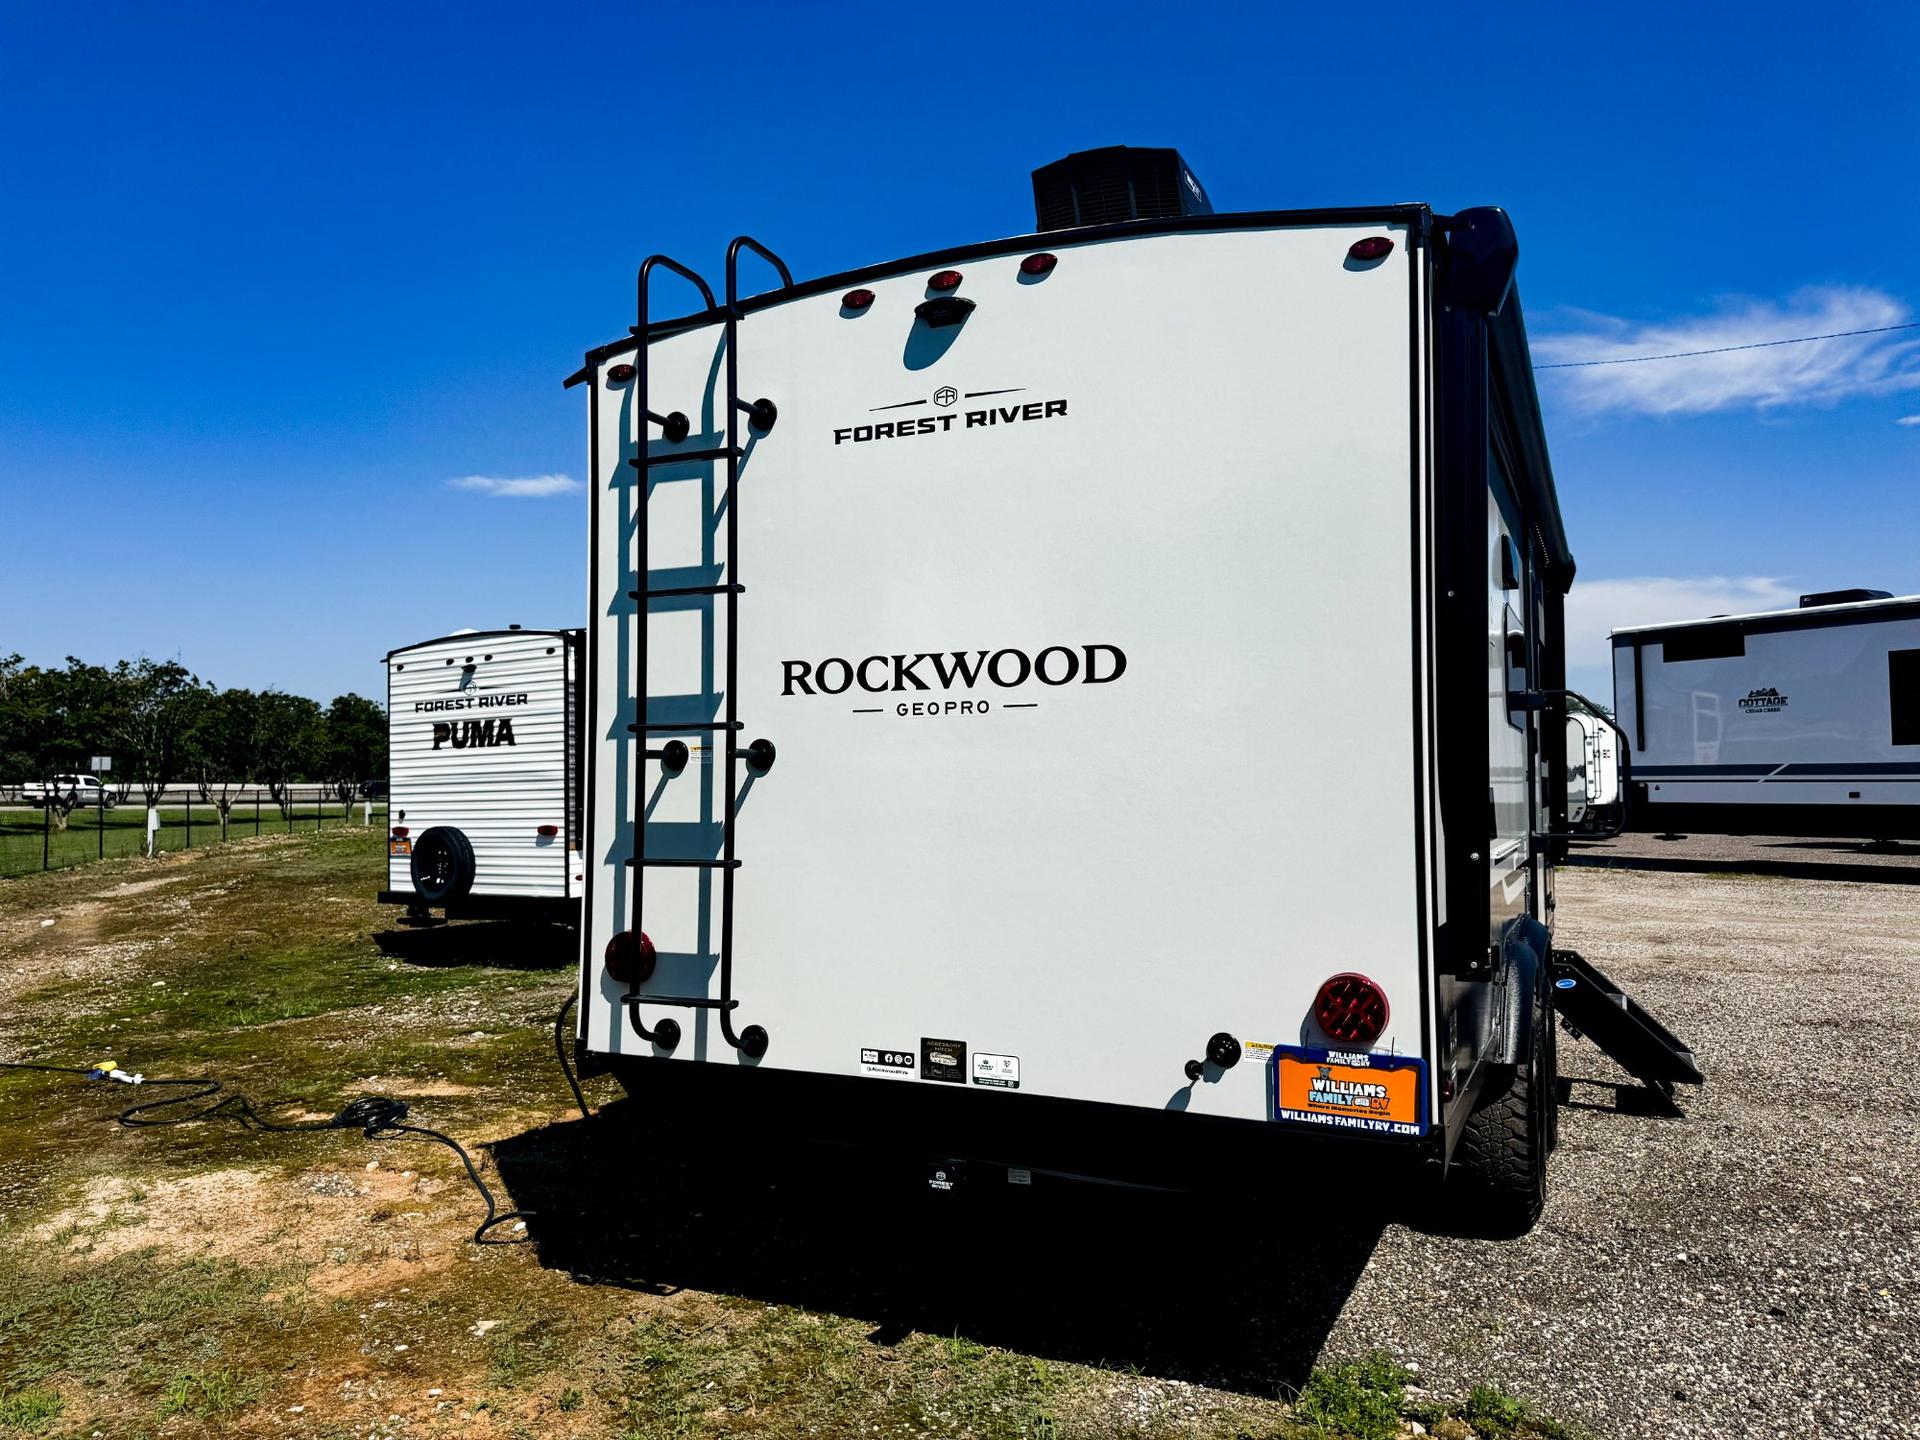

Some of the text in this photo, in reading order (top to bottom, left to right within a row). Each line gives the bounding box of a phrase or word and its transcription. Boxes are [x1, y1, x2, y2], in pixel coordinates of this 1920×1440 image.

[833, 399, 1068, 445] FOREST RIVER
[780, 644, 1127, 696] ROCKWOOD
[415, 694, 528, 713] FOREST RIVER
[896, 700, 990, 716] GEOPRO
[1738, 696, 1789, 707] COTTAGE
[432, 718, 517, 750] PUMA
[1326, 1058, 1353, 1066] FAMILY
[1328, 1051, 1370, 1061] WILLIAMS
[1312, 1078, 1386, 1098] WILLIAMS
[1309, 1091, 1390, 1110] FAMILY RV
[1331, 1105, 1368, 1114] Memories
